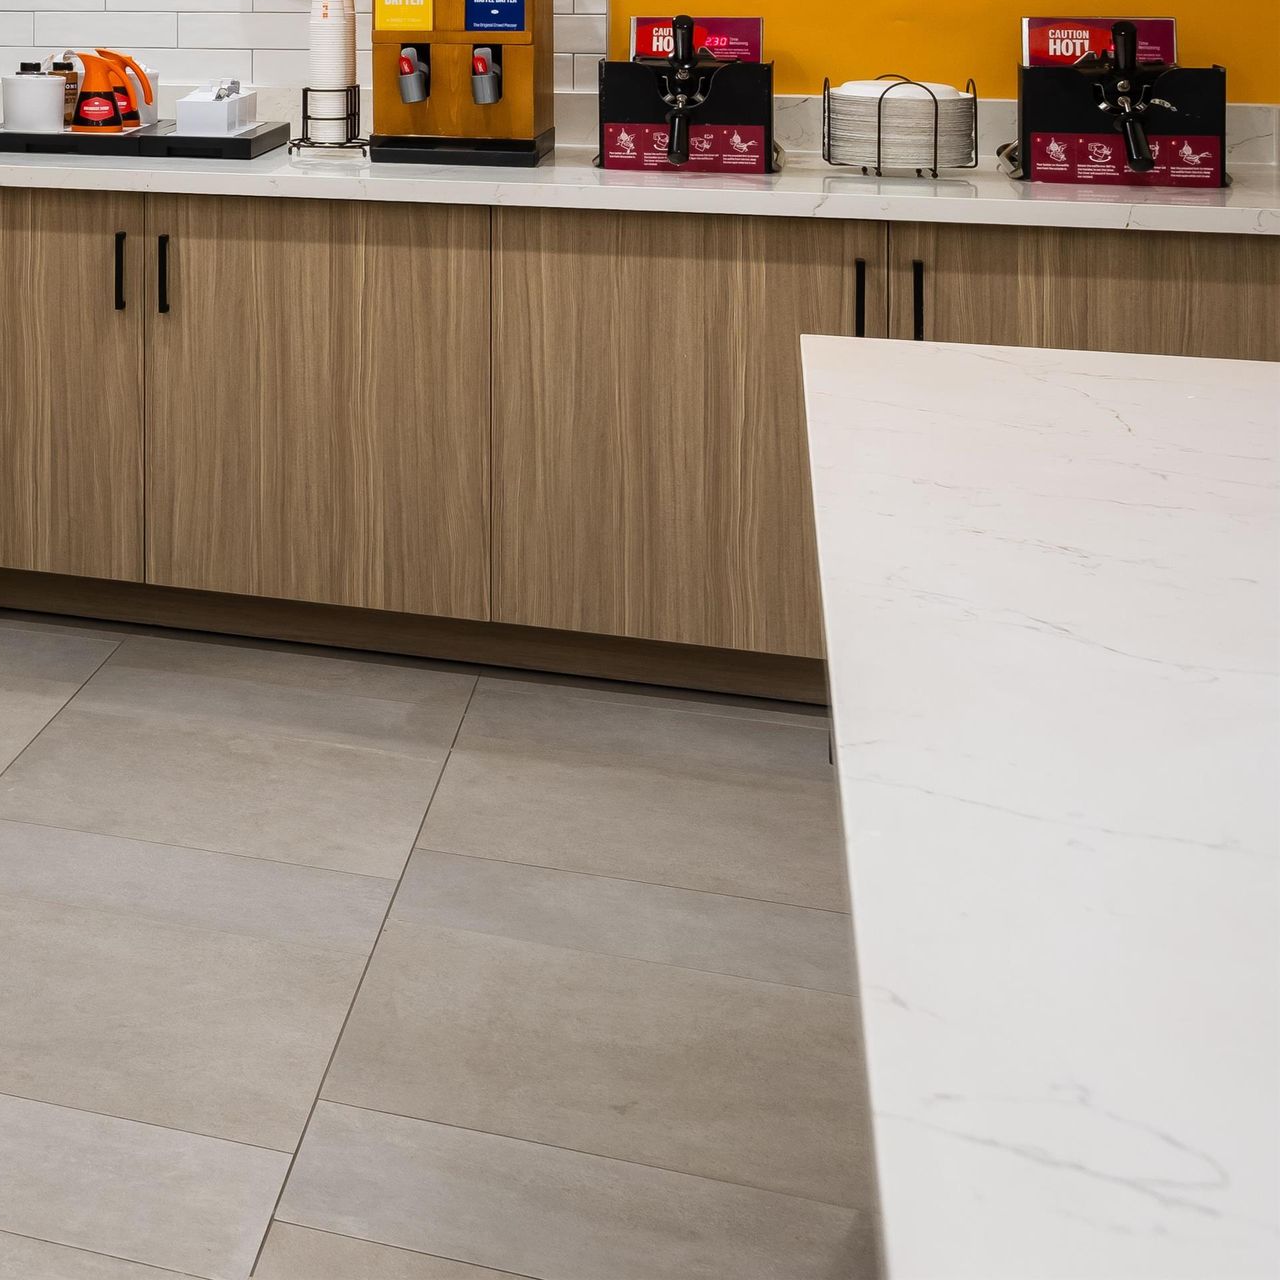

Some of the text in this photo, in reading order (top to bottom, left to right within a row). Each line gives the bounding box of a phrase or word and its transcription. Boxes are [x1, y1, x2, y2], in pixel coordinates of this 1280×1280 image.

[652, 27, 673, 36] CAUT
[1048, 29, 1090, 39] CAUTION
[652, 36, 675, 52] HO
[1048, 39, 1090, 56] HOT!
